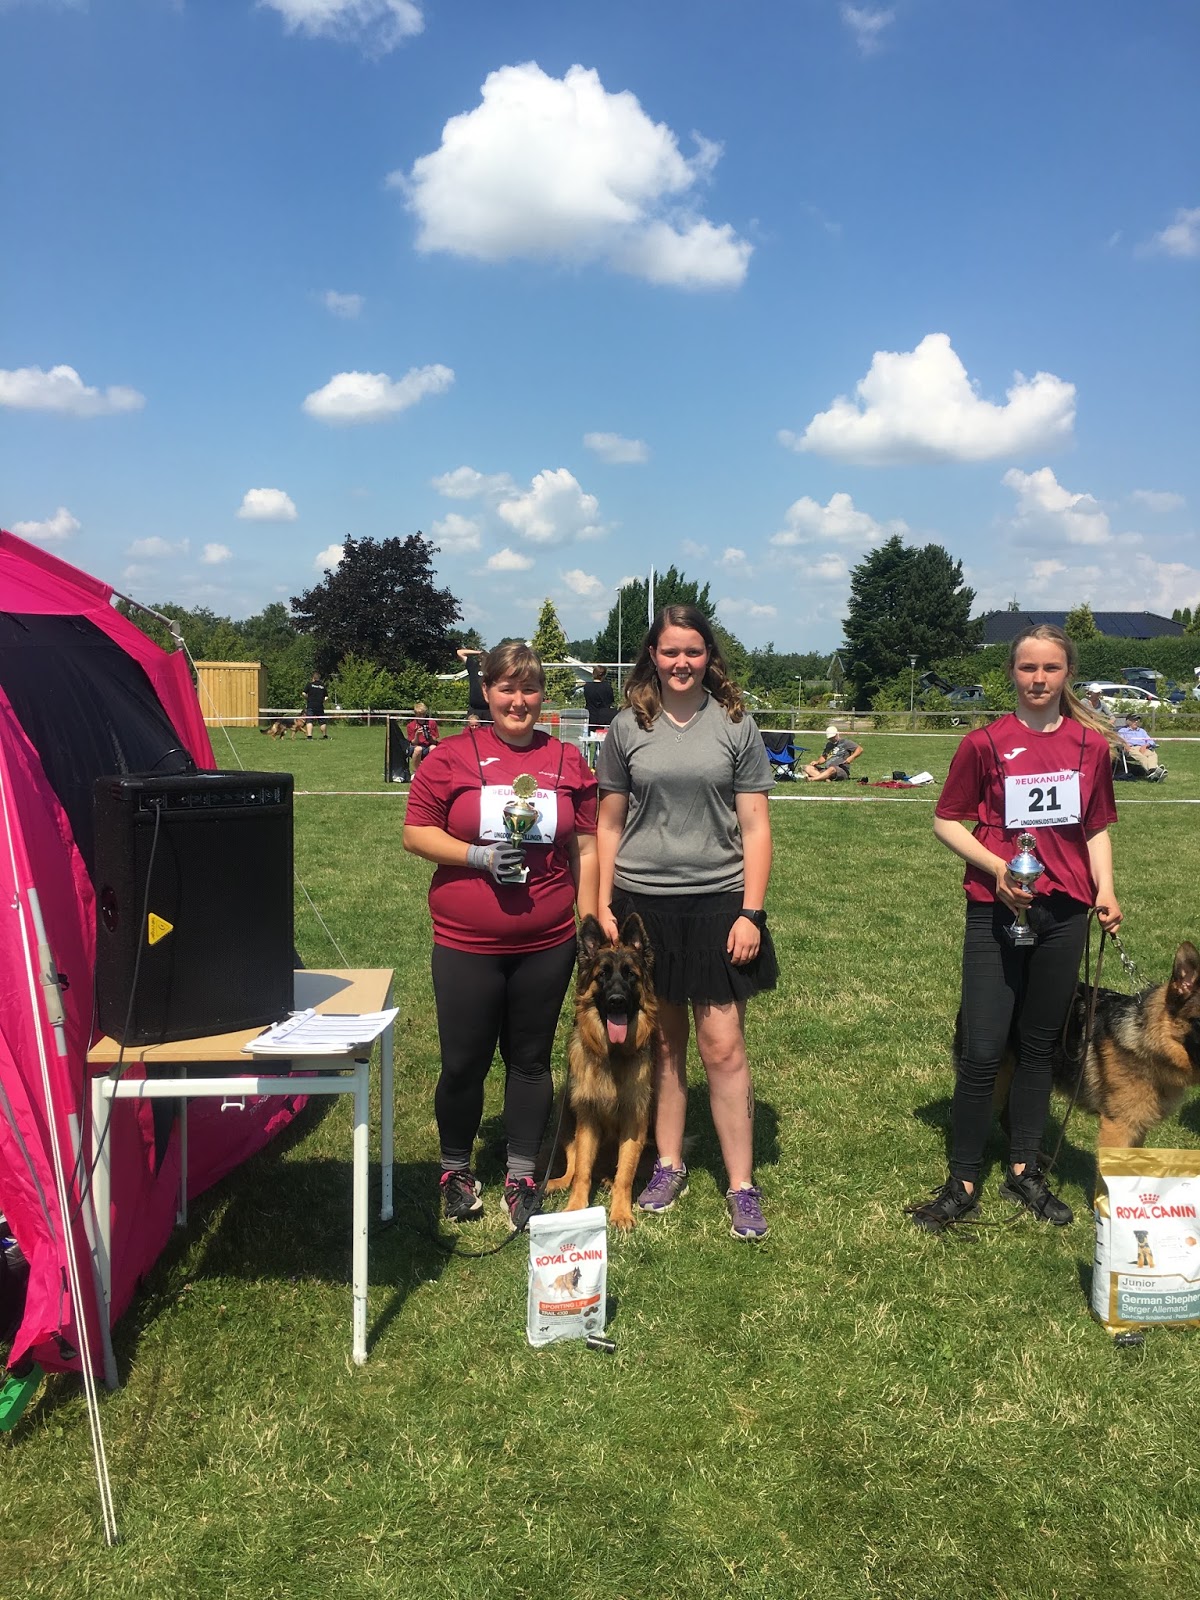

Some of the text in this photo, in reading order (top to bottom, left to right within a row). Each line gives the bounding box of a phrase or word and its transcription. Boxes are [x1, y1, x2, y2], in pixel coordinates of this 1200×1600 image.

[1021, 774, 1072, 785] EUKANUBA
[1028, 786, 1061, 812] 21
[1116, 1205, 1197, 1219] ROYAL CANIN
[535, 1249, 603, 1267] ROYAL CANIN
[1122, 1277, 1156, 1288] Junior
[1121, 1293, 1200, 1305] German Shepher
[541, 1302, 575, 1310] SPORTING
[1121, 1304, 1188, 1315] Berger Allemand
